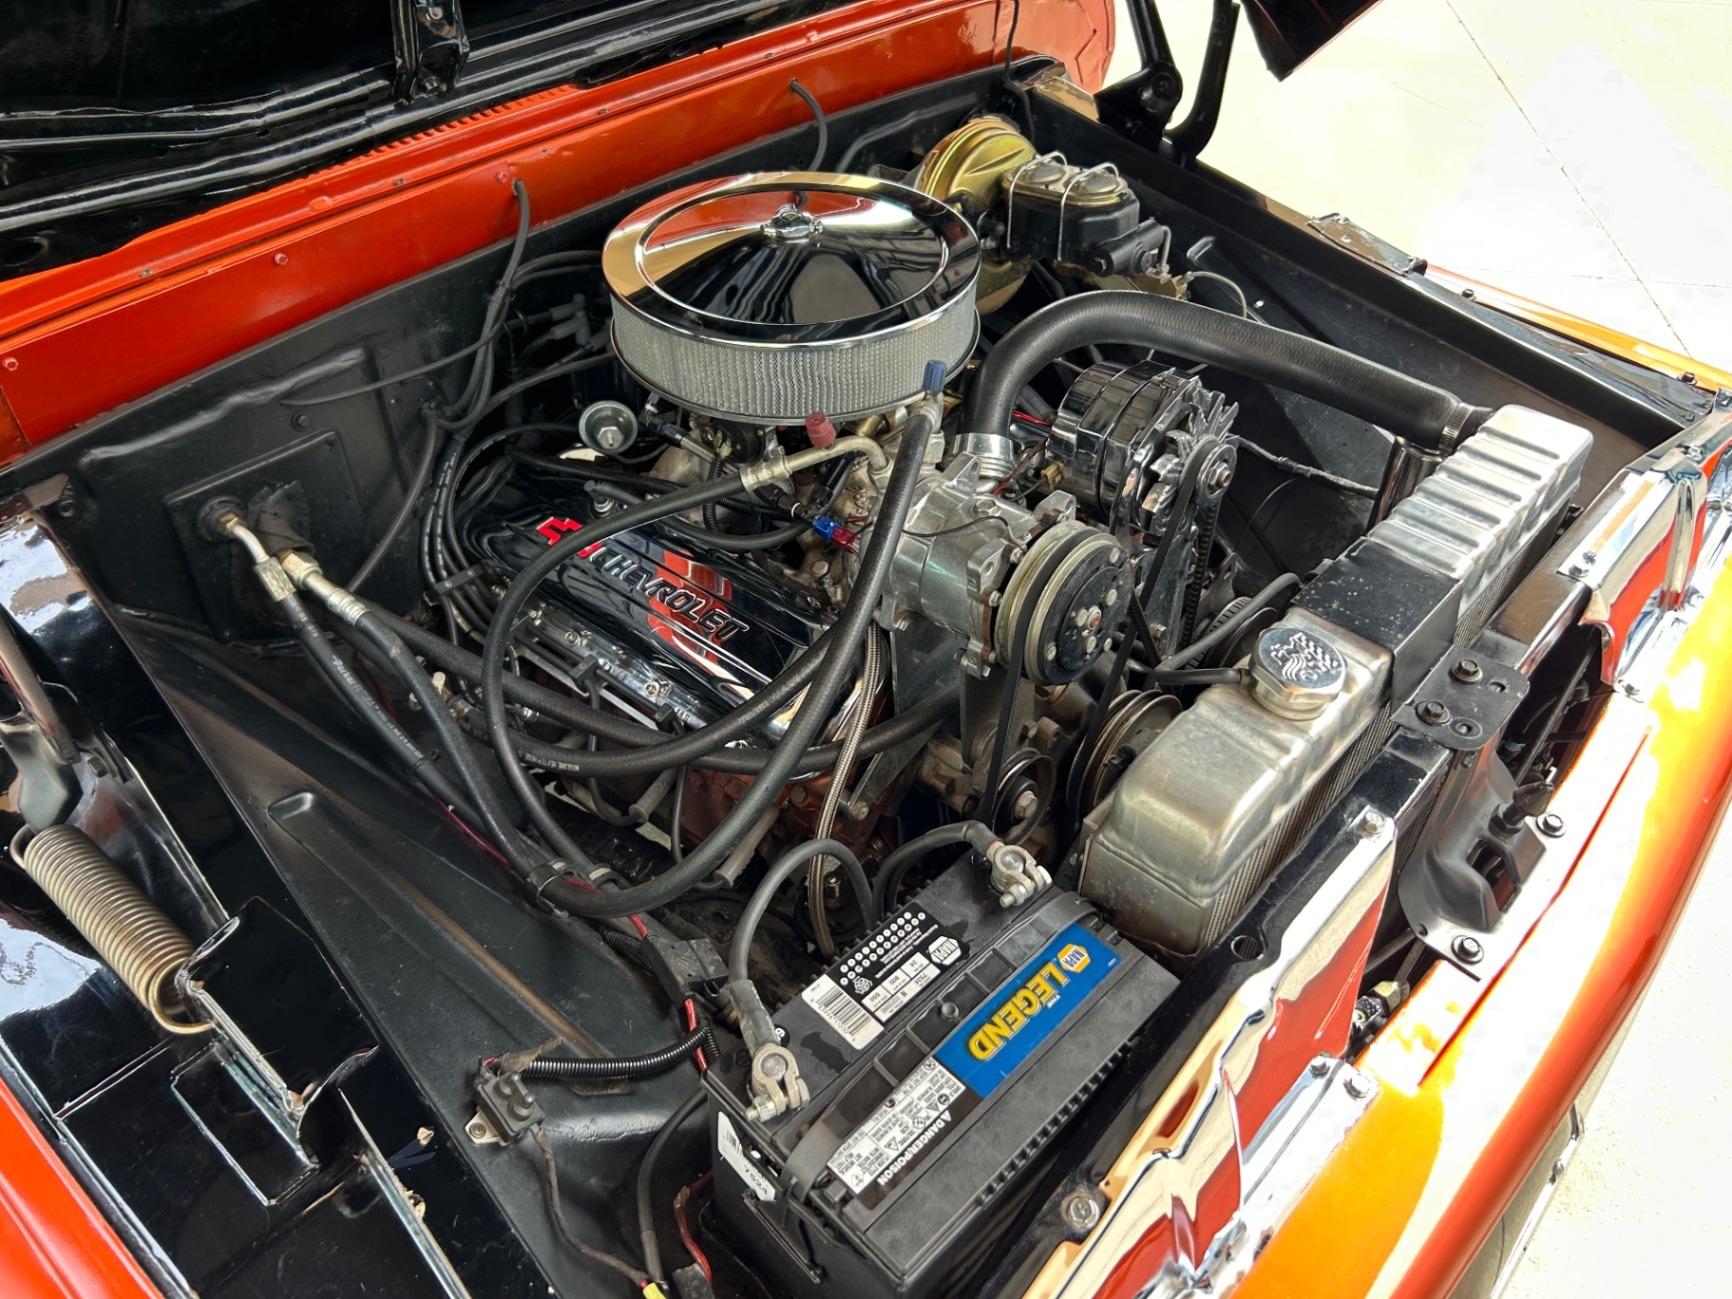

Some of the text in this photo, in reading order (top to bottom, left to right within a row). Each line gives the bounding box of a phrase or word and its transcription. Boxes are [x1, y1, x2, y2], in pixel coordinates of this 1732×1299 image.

[590, 547, 750, 640] CHEVROLET
[932, 940, 956, 961] NAPA
[1063, 948, 1085, 968] NAPA
[967, 960, 1070, 1061] LEGEND
[876, 1117, 944, 1186] DANGER/POISON
